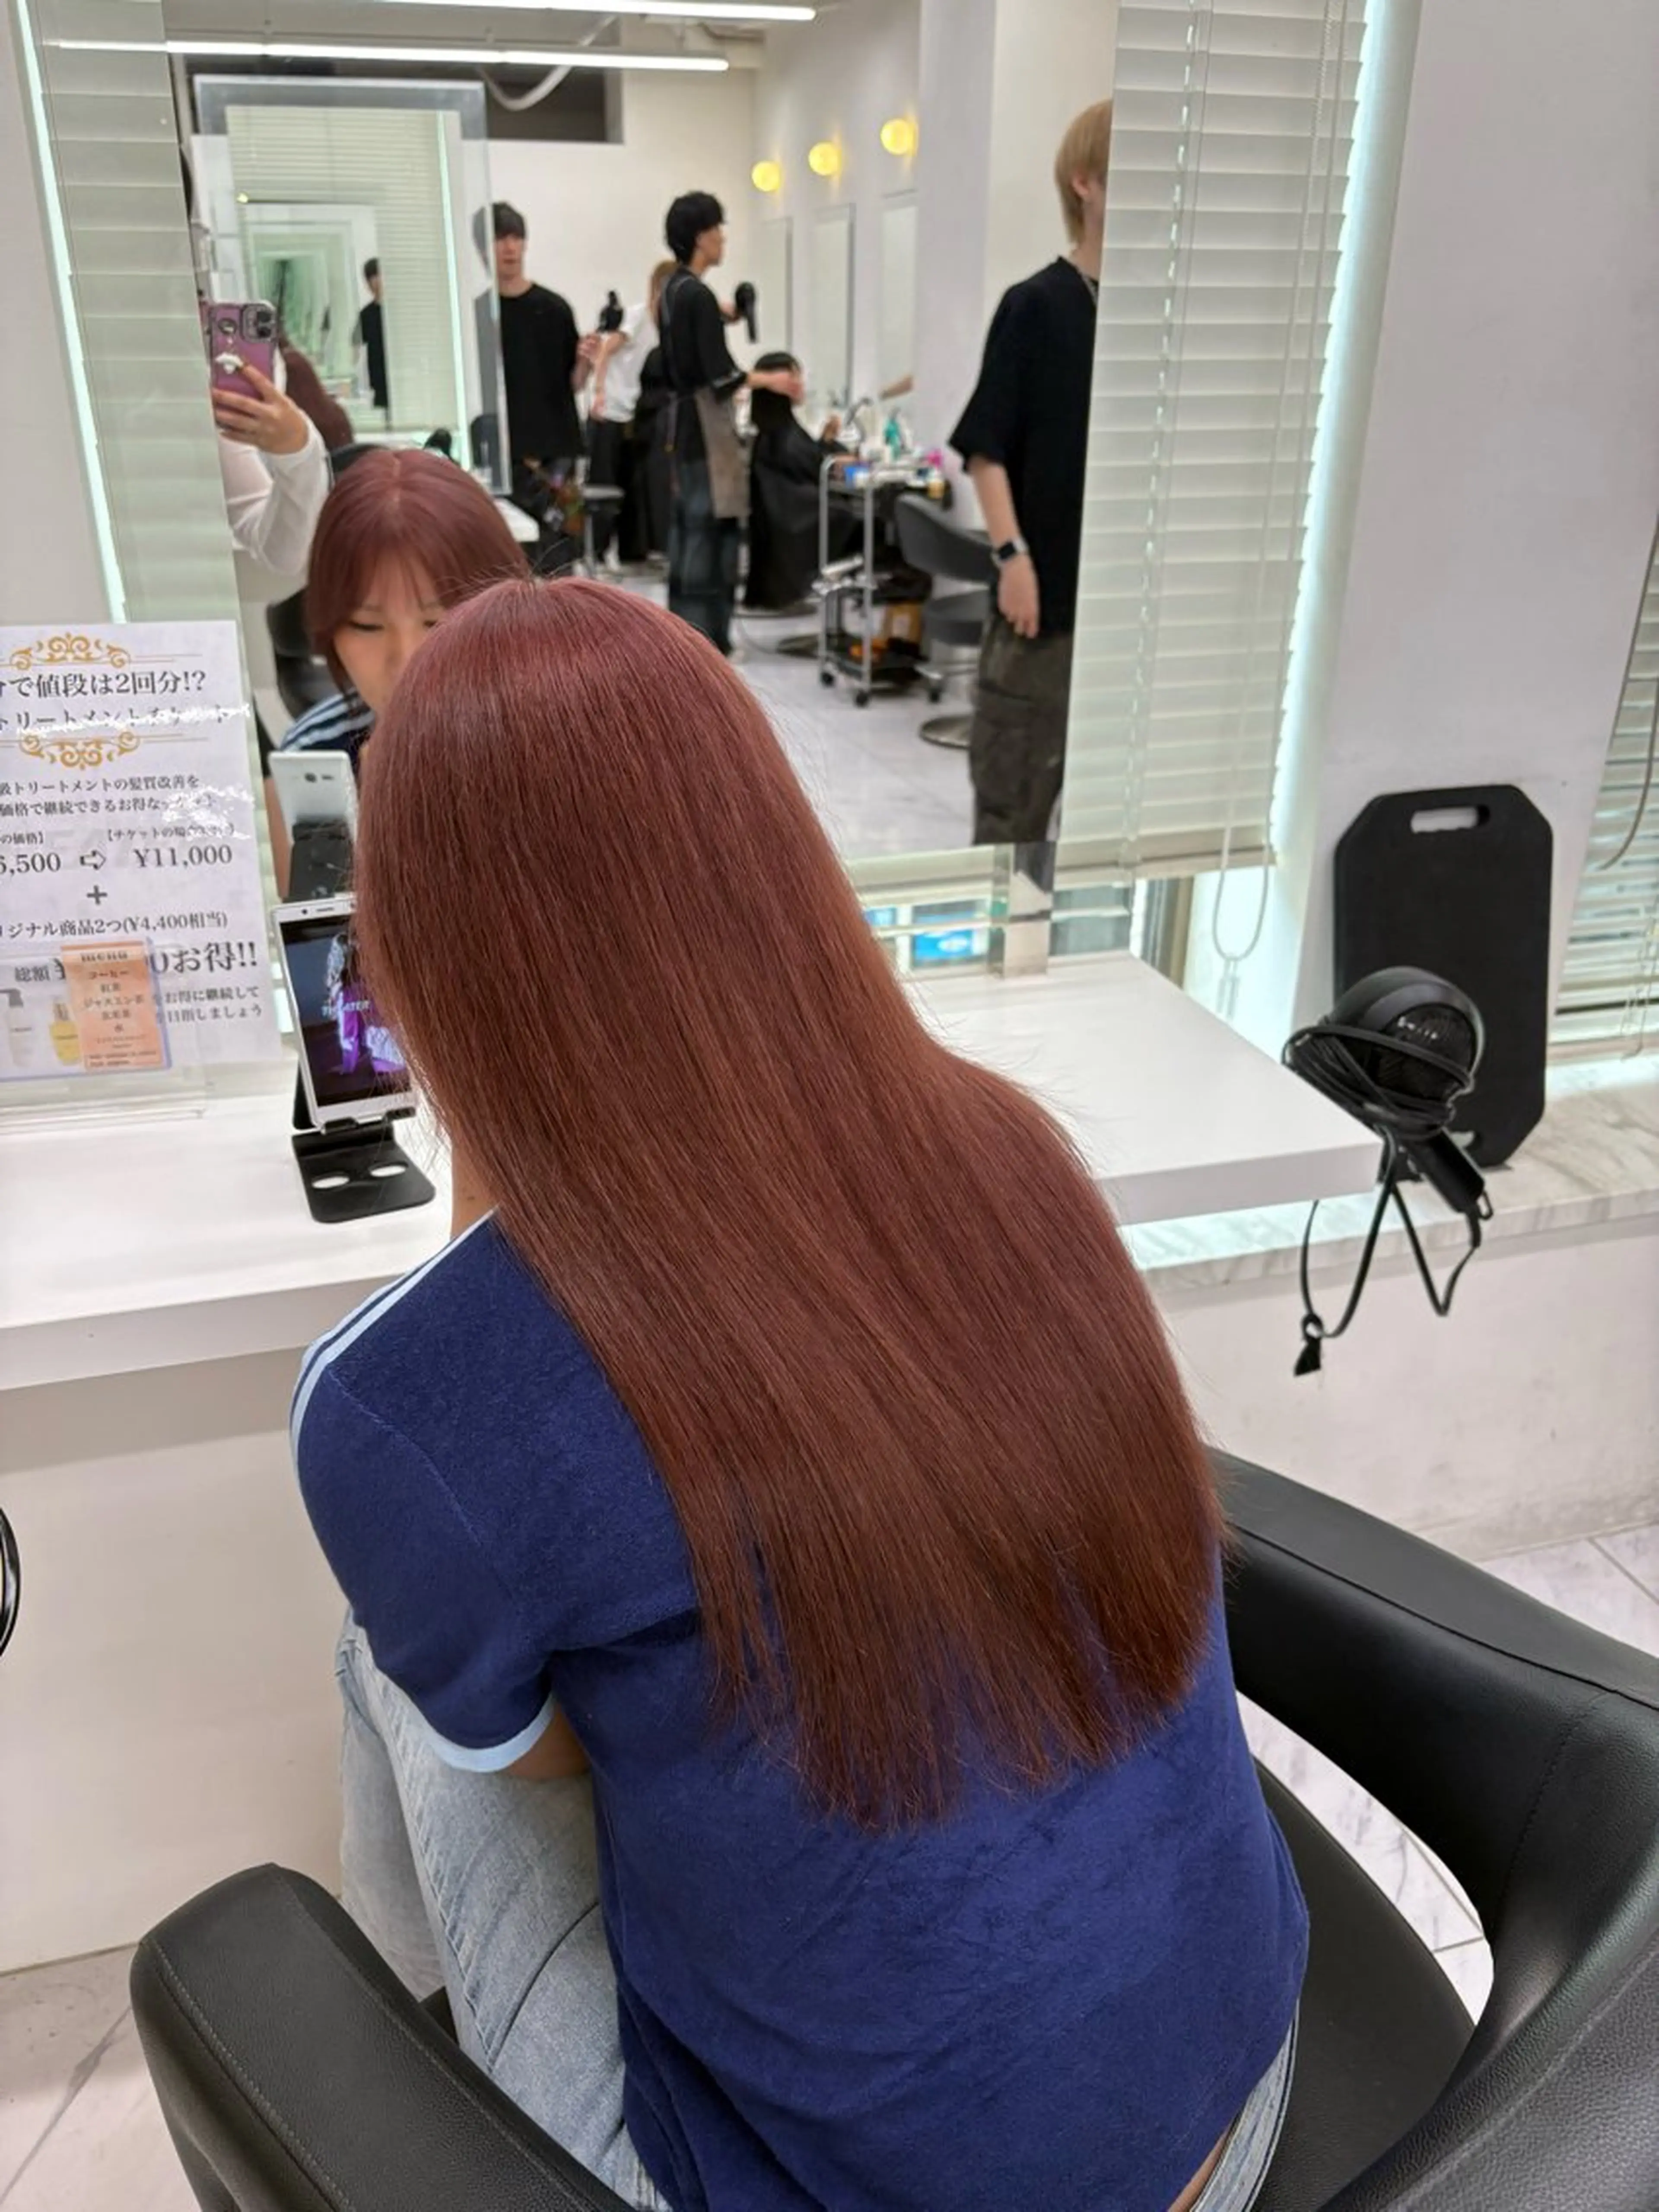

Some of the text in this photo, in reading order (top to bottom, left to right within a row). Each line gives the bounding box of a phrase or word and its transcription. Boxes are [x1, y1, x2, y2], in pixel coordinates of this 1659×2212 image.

[134, 845, 232, 868] ¥11,000
[0, 912, 228, 939] ジナル商品2つ(¥4,400相当)
